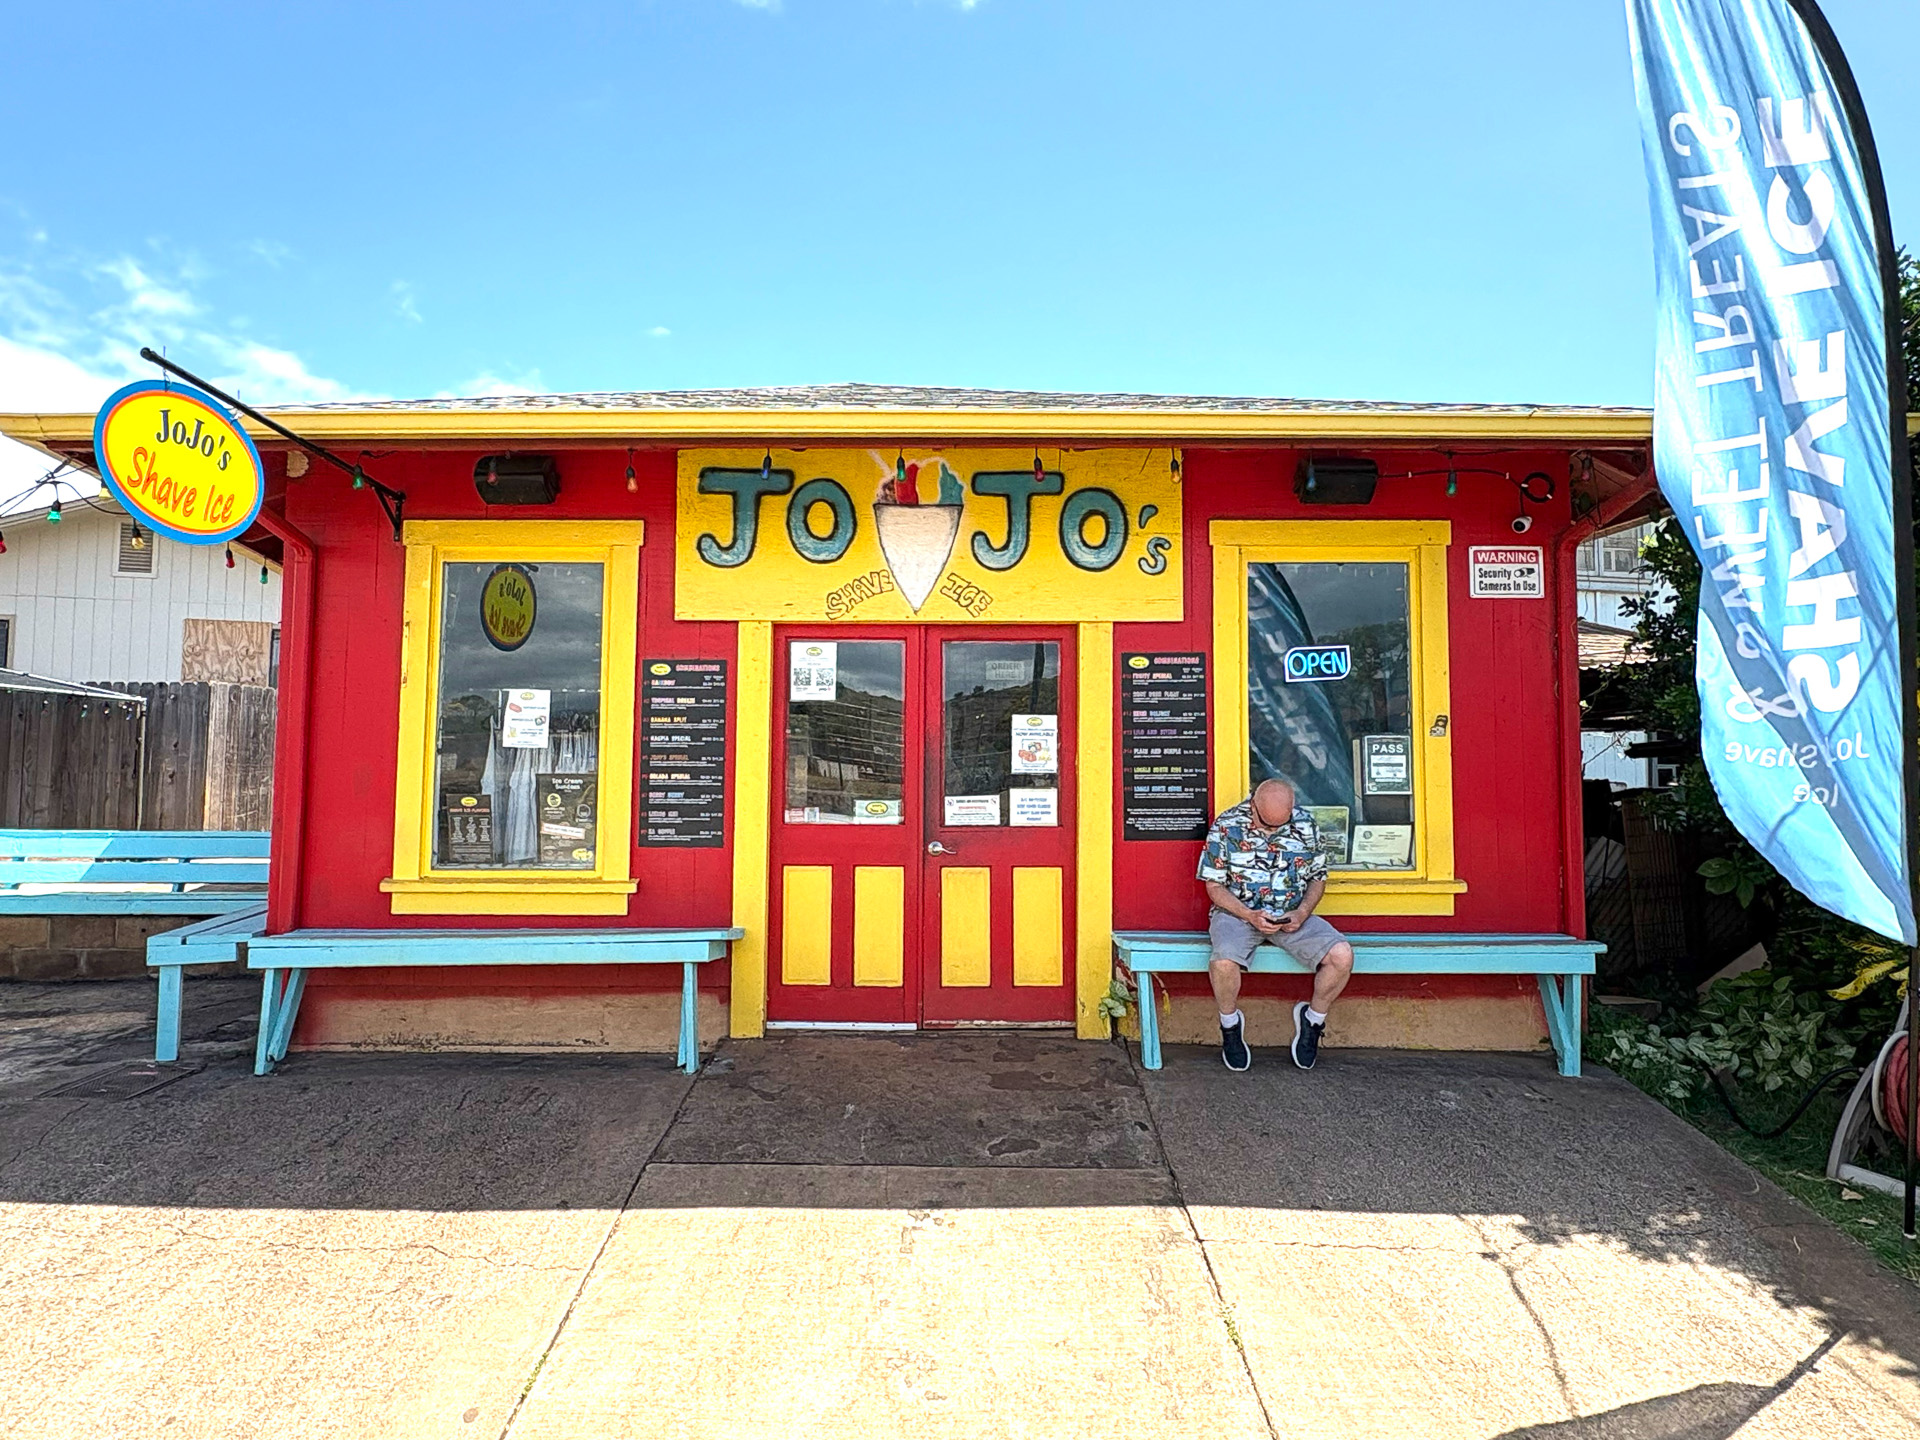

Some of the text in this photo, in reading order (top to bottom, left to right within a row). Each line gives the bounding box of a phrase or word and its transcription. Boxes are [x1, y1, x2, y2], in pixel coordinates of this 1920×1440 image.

[156, 410, 232, 471] JoJo's
[127, 446, 235, 523] Shave Ice
[1476, 552, 1536, 562] WARNING
[1478, 568, 1512, 580] Security
[825, 569, 993, 620] SHAVE ICE
[1479, 580, 1537, 591] Cameras In Use
[1288, 650, 1346, 677] OPEN
[1372, 744, 1404, 754] PASS
